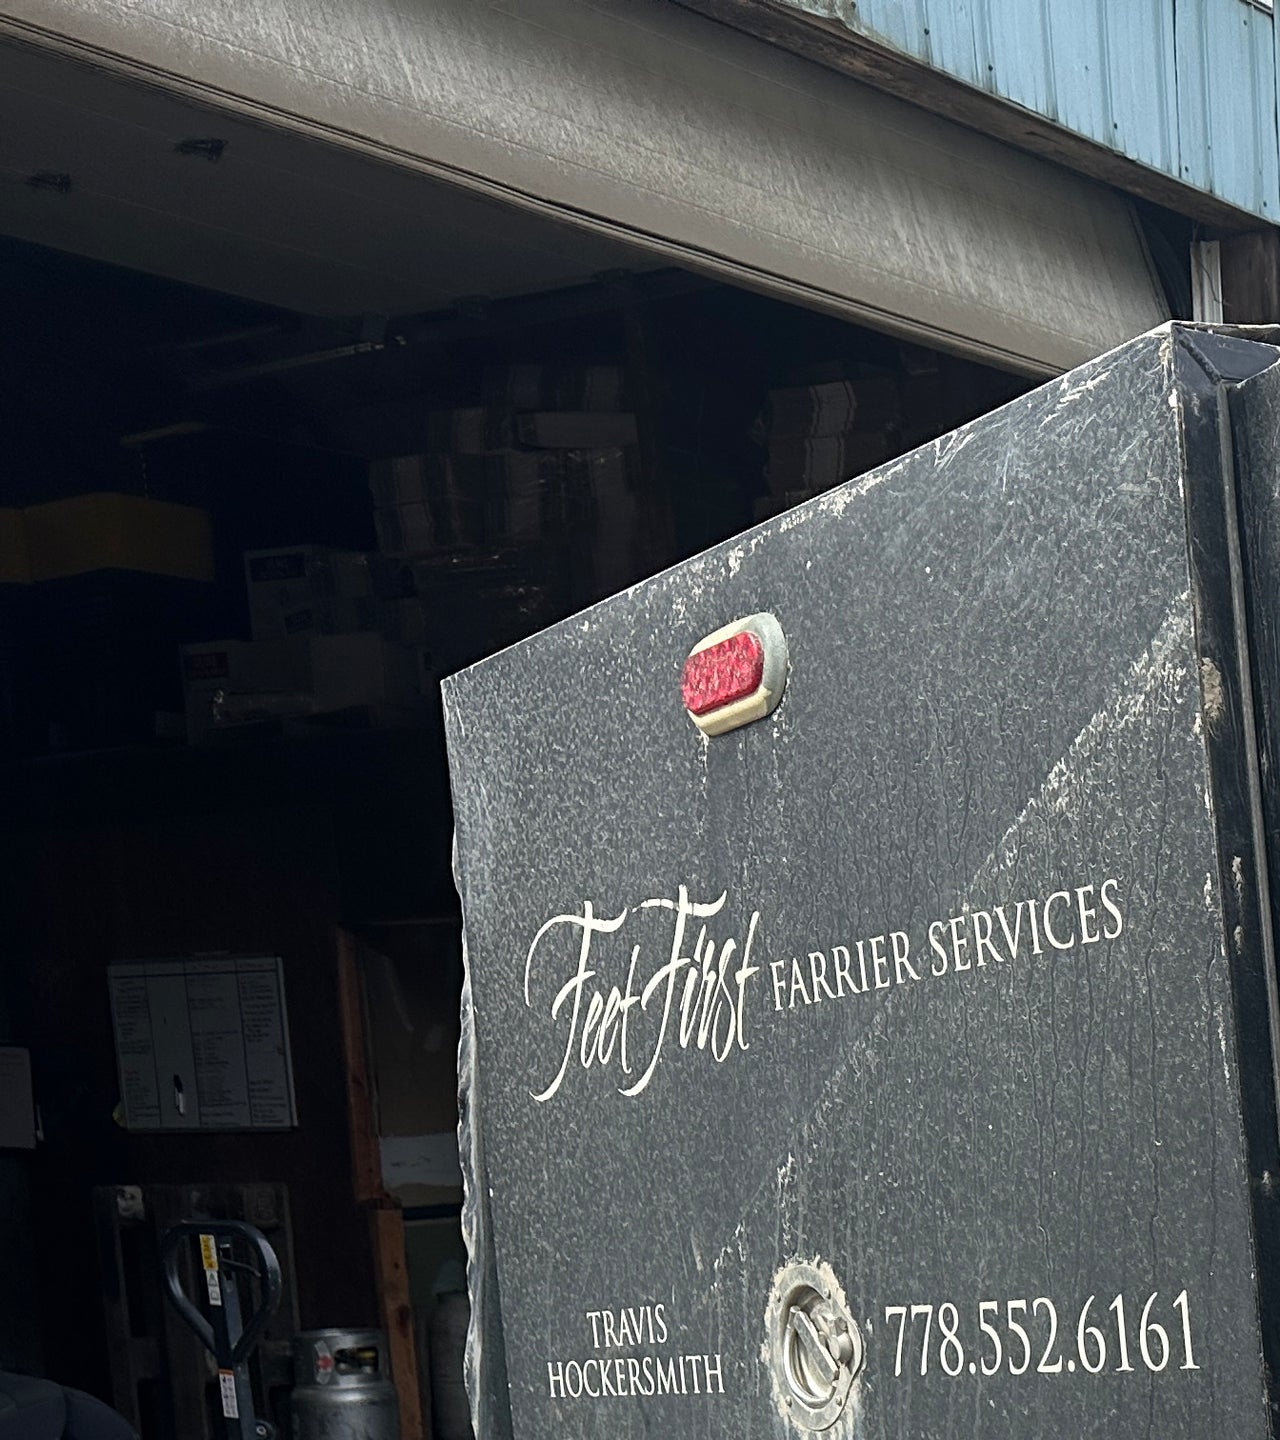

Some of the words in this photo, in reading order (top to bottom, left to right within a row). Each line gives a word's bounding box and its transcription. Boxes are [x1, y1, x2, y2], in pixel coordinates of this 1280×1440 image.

[525, 900, 641, 1102] Feet
[618, 884, 760, 1097] First
[769, 930, 921, 1012] FARRIER
[928, 878, 1124, 977] SERVICES
[586, 1303, 668, 1349] TRAVIS
[885, 1289, 1200, 1377] 778.552.6161
[547, 1354, 725, 1398] HOCKERSMITH
